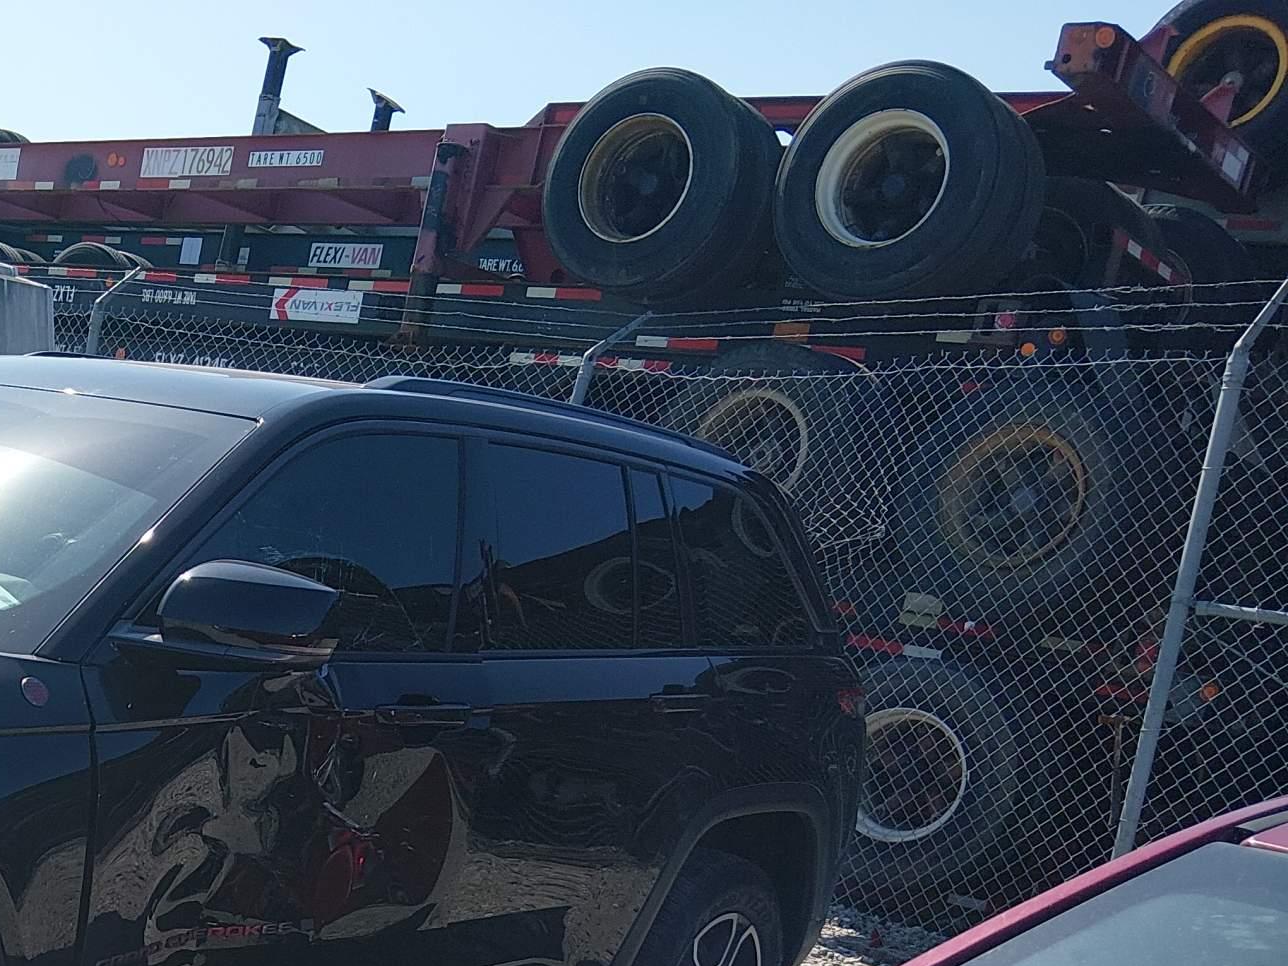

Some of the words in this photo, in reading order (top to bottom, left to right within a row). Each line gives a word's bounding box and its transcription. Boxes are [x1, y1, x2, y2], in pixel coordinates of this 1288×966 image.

[250, 152, 275, 166] TARE
[295, 151, 322, 165] 6500
[479, 258, 497, 272] TARE
